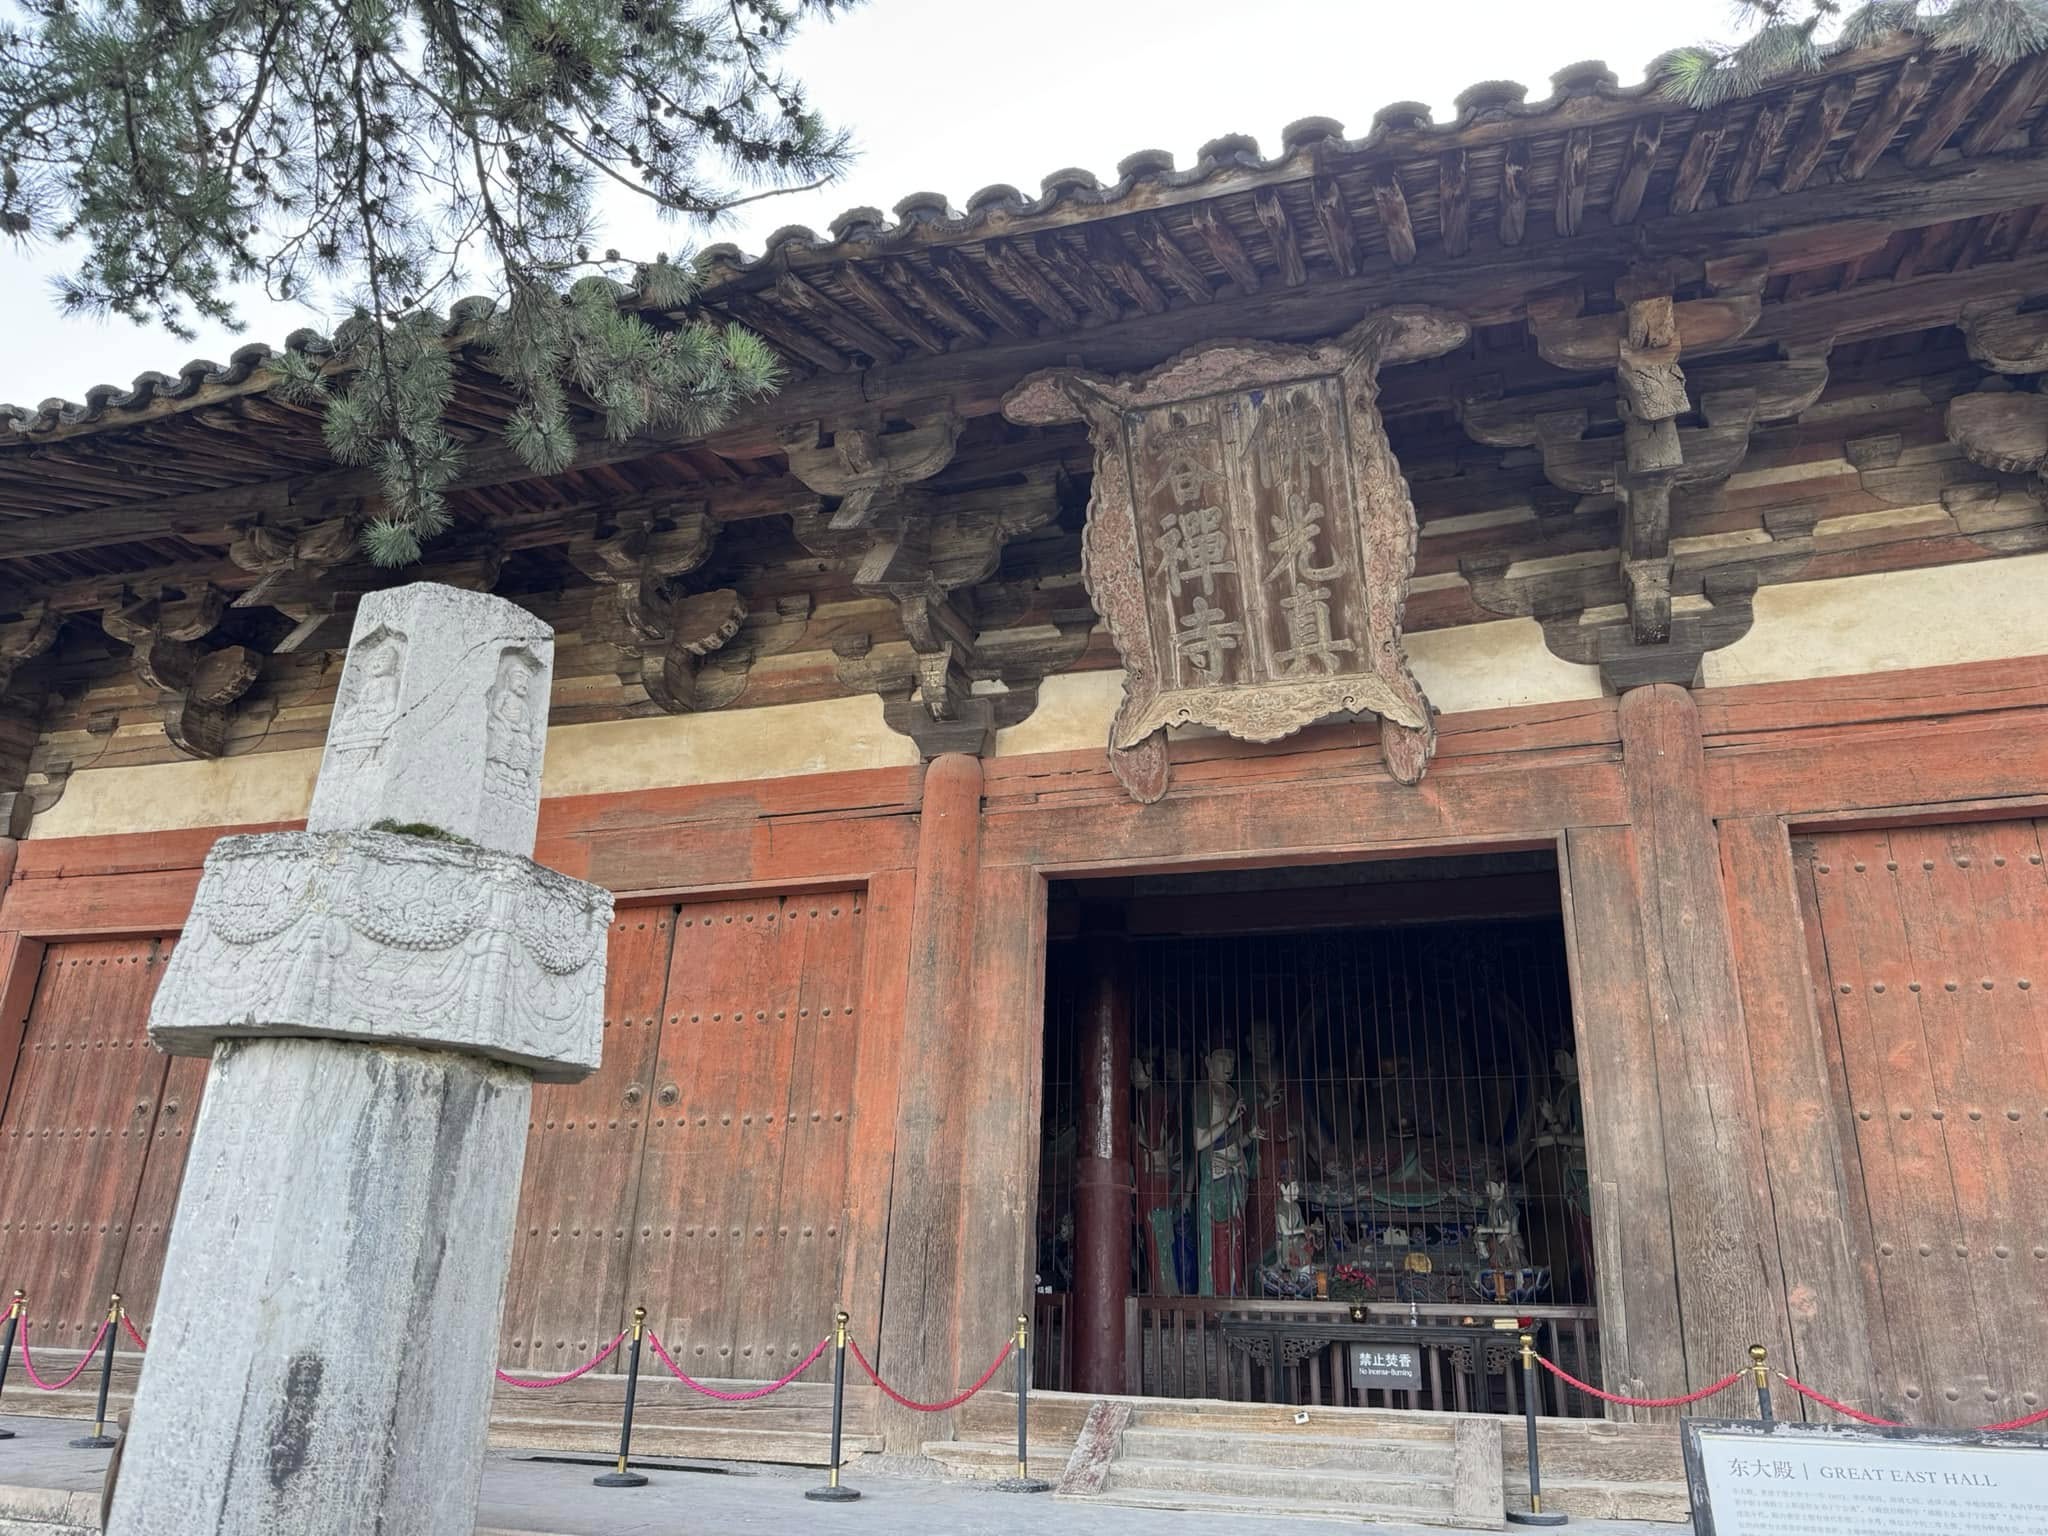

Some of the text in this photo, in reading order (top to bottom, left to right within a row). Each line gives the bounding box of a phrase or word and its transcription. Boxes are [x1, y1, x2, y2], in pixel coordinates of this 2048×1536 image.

[1359, 1352, 1412, 1368] 禁止焚香
[1728, 1458, 1795, 1480] 东大殿
[1820, 1466, 1998, 1487] GREAT EAST HALL
